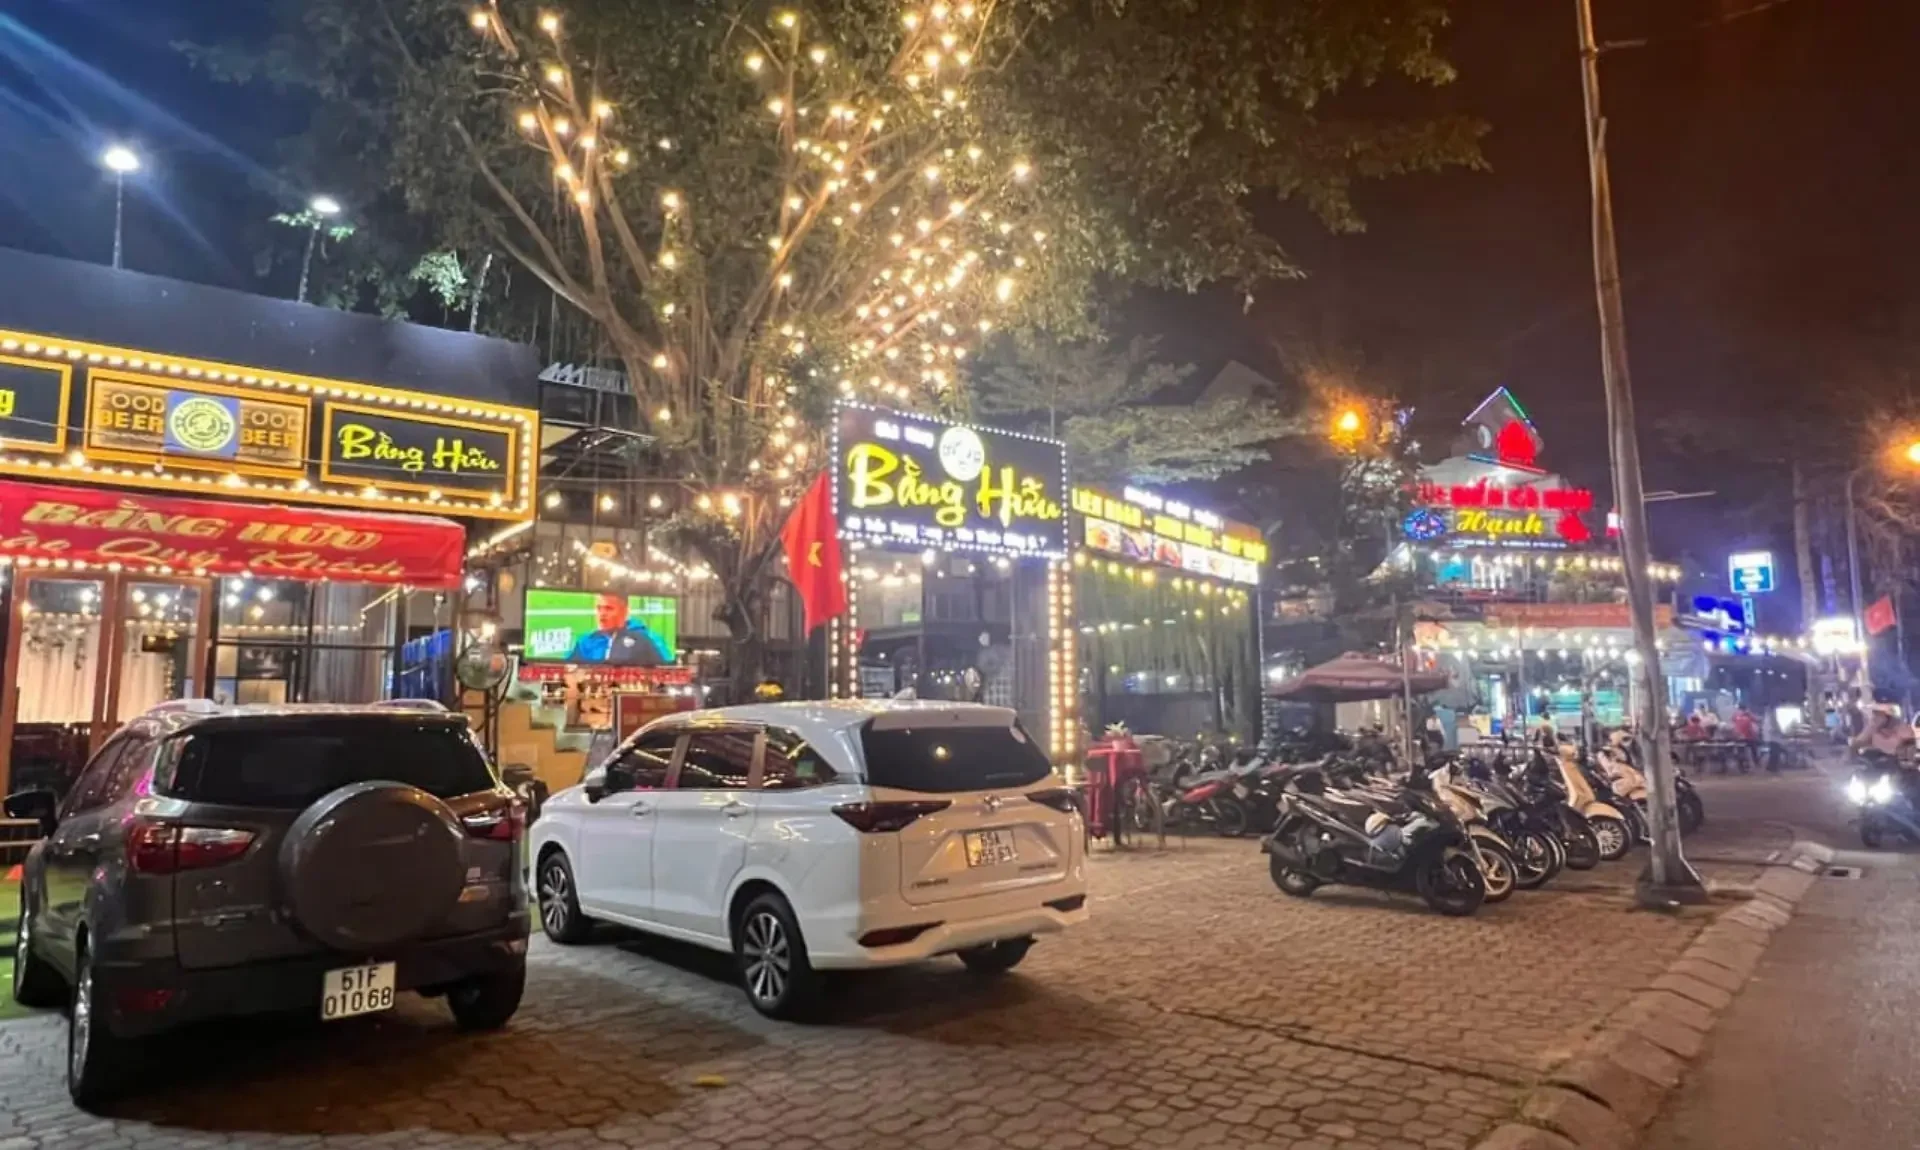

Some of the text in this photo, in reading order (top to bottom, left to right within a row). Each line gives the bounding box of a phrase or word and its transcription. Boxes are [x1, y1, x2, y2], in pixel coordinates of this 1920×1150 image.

[97, 408, 165, 434] BEER
[240, 408, 299, 431] FOOD
[240, 427, 297, 448] BEER
[847, 442, 967, 527] Bằng
[1456, 509, 1545, 539] Hạnh
[341, 966, 379, 992] 51F
[325, 986, 392, 1016] 01068
